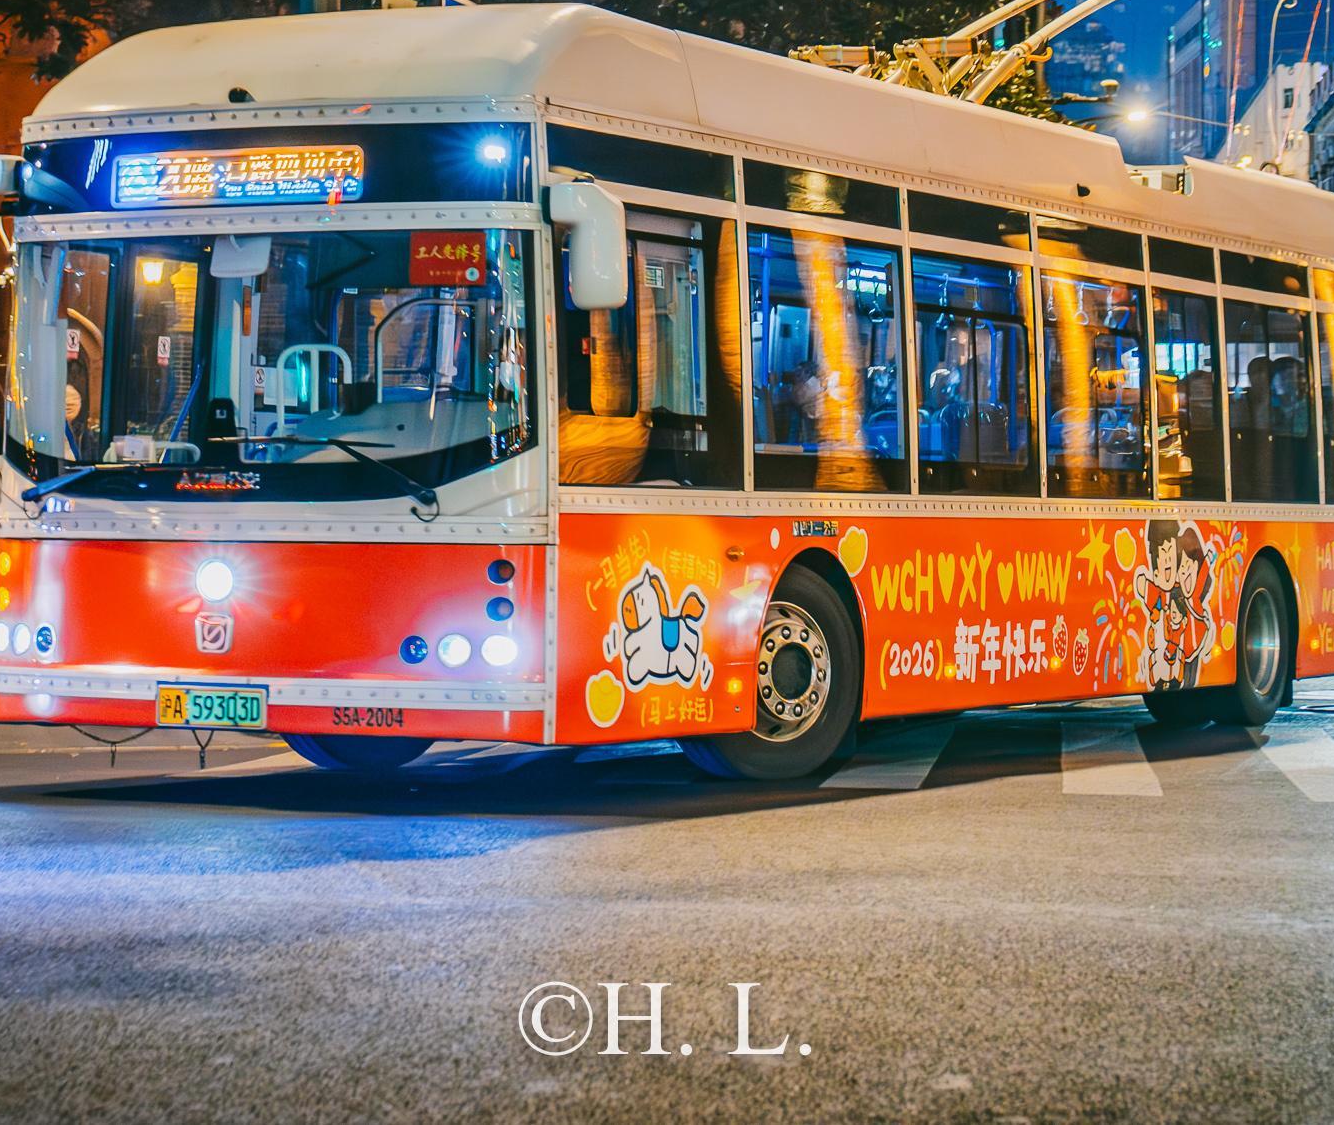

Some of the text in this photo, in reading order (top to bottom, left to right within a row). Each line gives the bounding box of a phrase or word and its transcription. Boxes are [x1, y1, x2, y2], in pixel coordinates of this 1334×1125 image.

[879, 617, 1049, 690] (2026) 新年快乐
[333, 707, 405, 728] S5A-2004
[640, 696, 714, 728] (马上好运)
